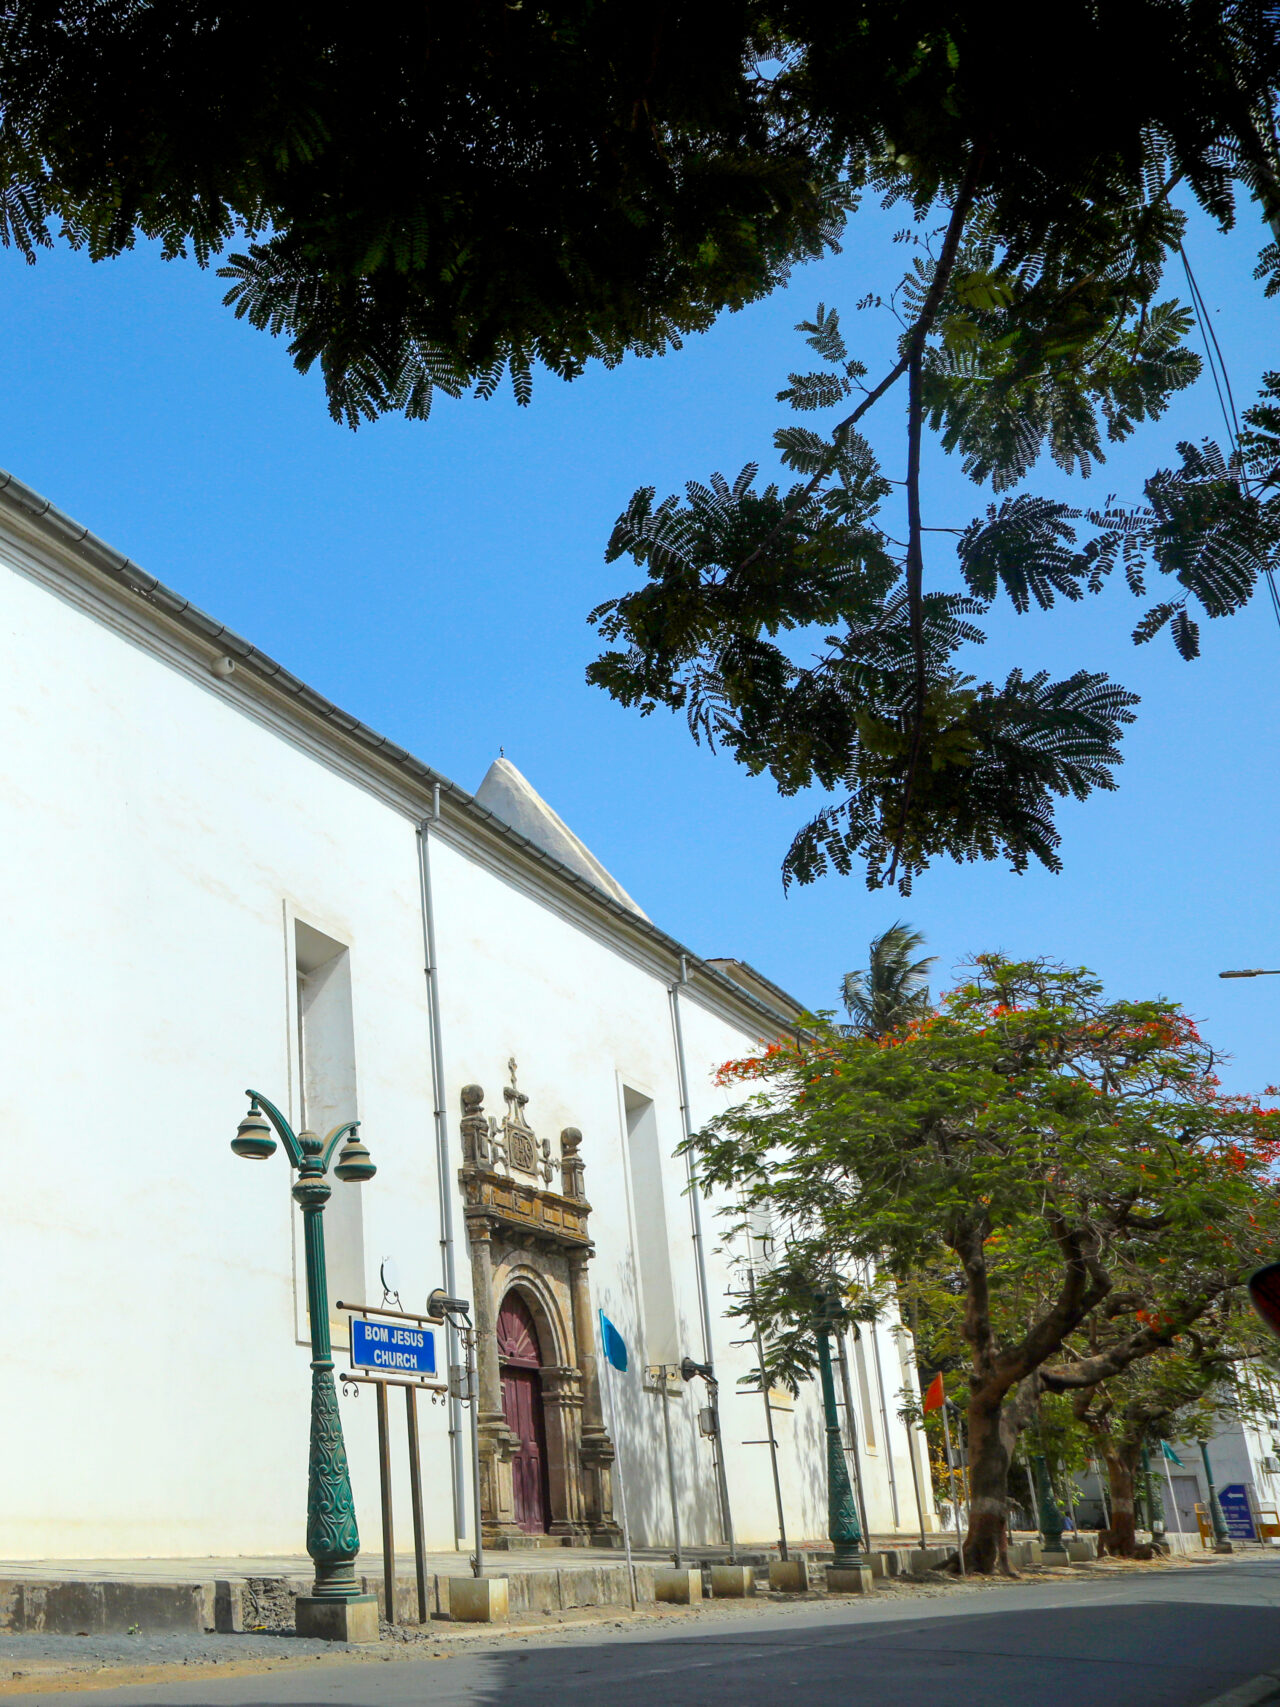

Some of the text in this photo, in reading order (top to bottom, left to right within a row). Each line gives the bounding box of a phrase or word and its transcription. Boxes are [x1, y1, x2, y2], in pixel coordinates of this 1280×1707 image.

[365, 1325, 424, 1347] BOM JESUS
[374, 1349, 417, 1369] CHURCH
